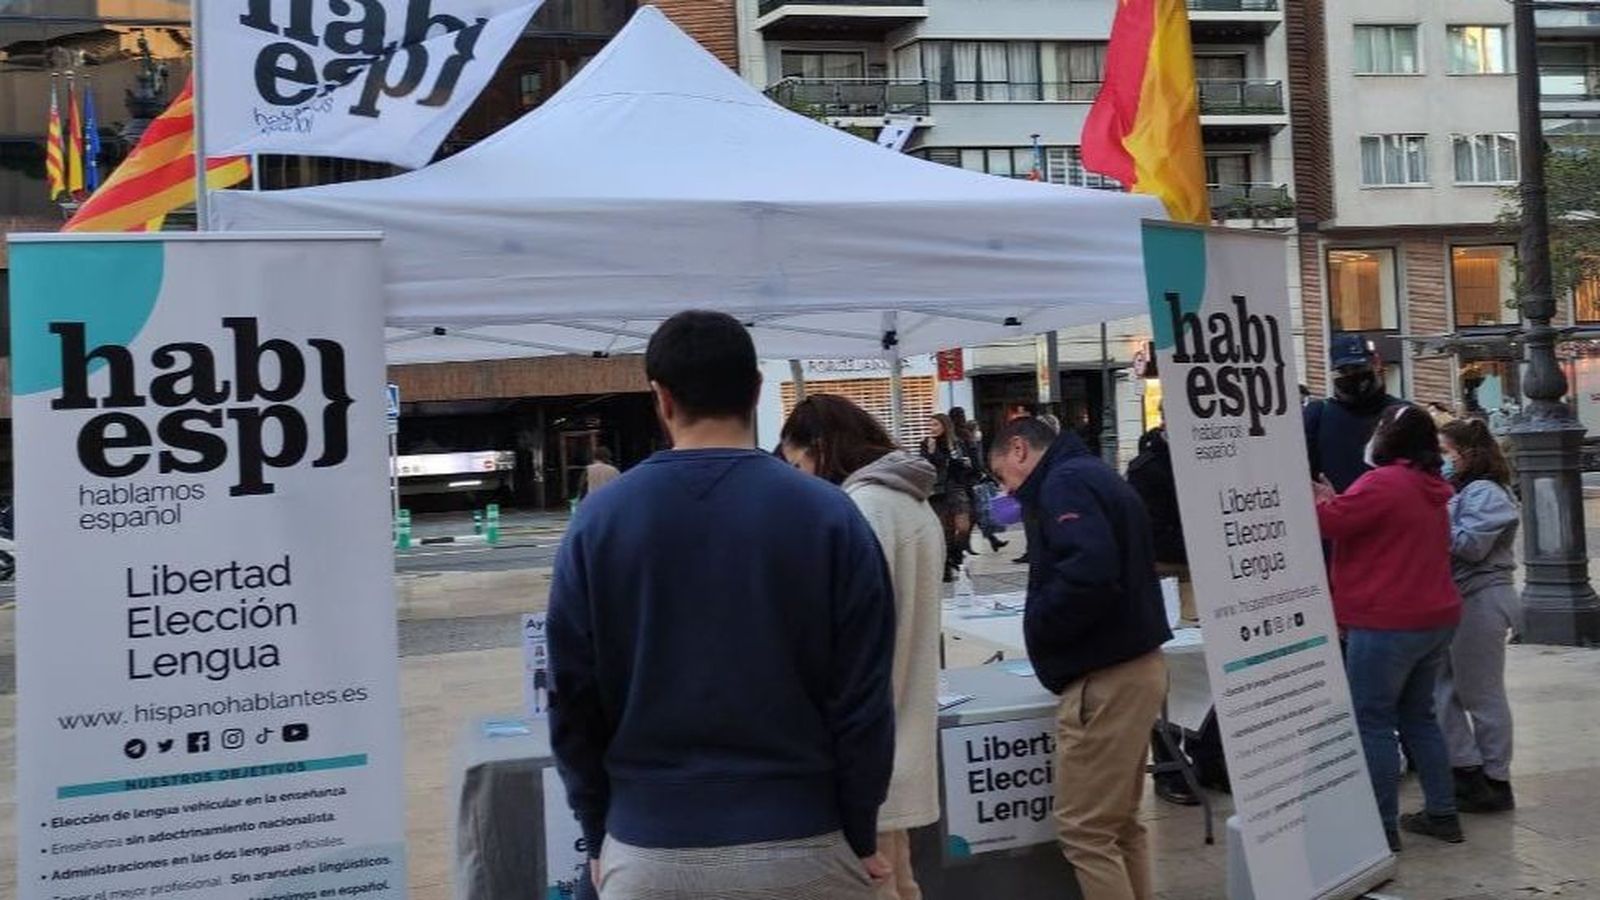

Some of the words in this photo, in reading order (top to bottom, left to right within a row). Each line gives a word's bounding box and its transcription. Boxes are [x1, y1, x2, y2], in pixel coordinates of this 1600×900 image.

[79, 482, 205, 506] hablamos
[1218, 484, 1280, 514] Libertad
[79, 503, 182, 533] español
[126, 554, 292, 598] Libertad
[1228, 551, 1286, 580] Lengua
[127, 597, 297, 639] Elección
[128, 643, 280, 681] Lengua
[58, 710, 128, 730] www.
[134, 686, 368, 724] hispanohablantes.es
[966, 732, 1057, 763] Libert
[125, 772, 213, 791] NUESTROS
[219, 761, 307, 780] OBJETIVOS
[967, 760, 1053, 795] Elecci
[51, 813, 110, 829] Elección
[112, 810, 131, 821] de
[133, 806, 179, 819] lengua
[182, 797, 242, 812] vehicular
[245, 795, 263, 806] en
[265, 793, 278, 803] la
[279, 786, 347, 801] enseñanza
[125, 835, 145, 846] sin
[147, 821, 255, 844] adoctrinamiento
[51, 857, 169, 881] Administraciones
[172, 855, 189, 865] en
[191, 852, 211, 863] las
[213, 850, 237, 861] dos
[239, 843, 291, 858] lenguas
[230, 873, 251, 885] Sin
[253, 864, 315, 882] aranceles
[320, 888, 336, 898] en
